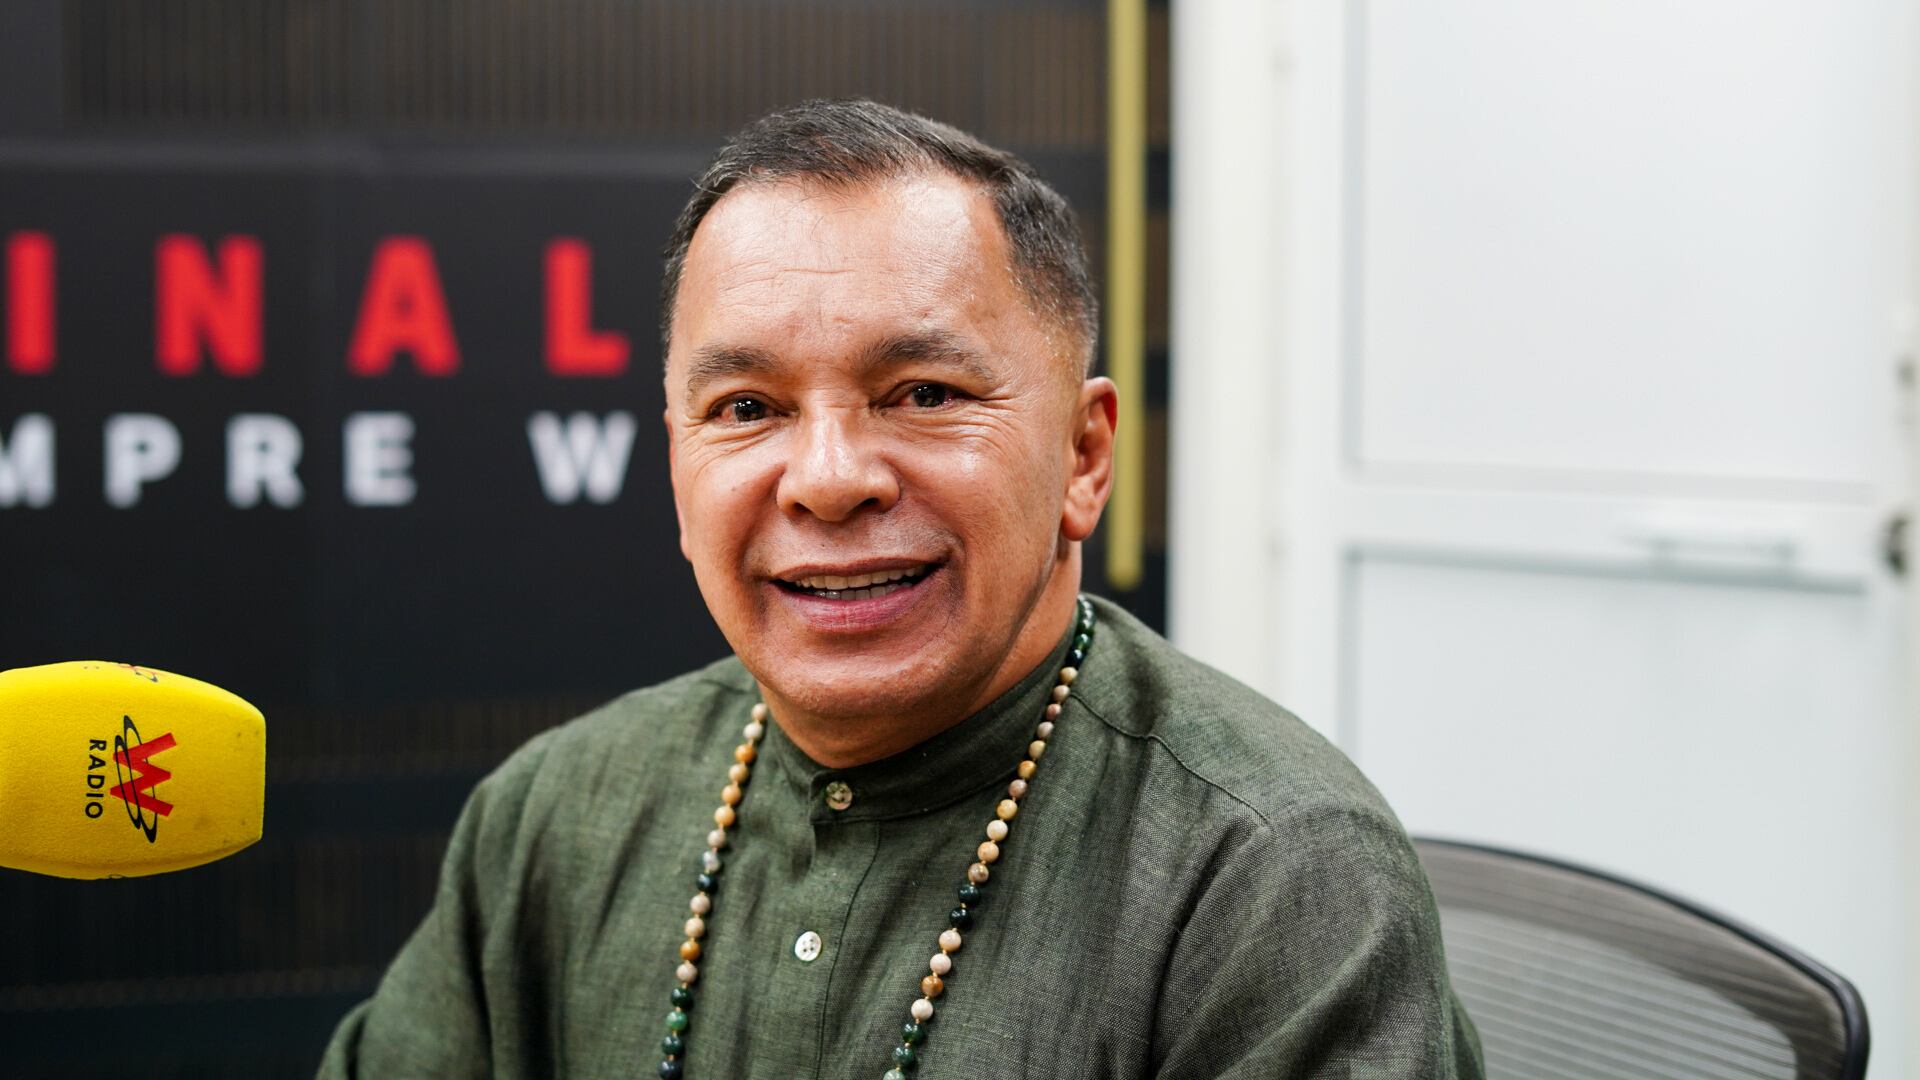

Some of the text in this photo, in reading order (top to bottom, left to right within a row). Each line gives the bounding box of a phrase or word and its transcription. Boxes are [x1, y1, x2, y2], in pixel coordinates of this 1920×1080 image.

[6, 230, 632, 378] INAL
[525, 410, 638, 505] W
[84, 738, 107, 819] RADIO
